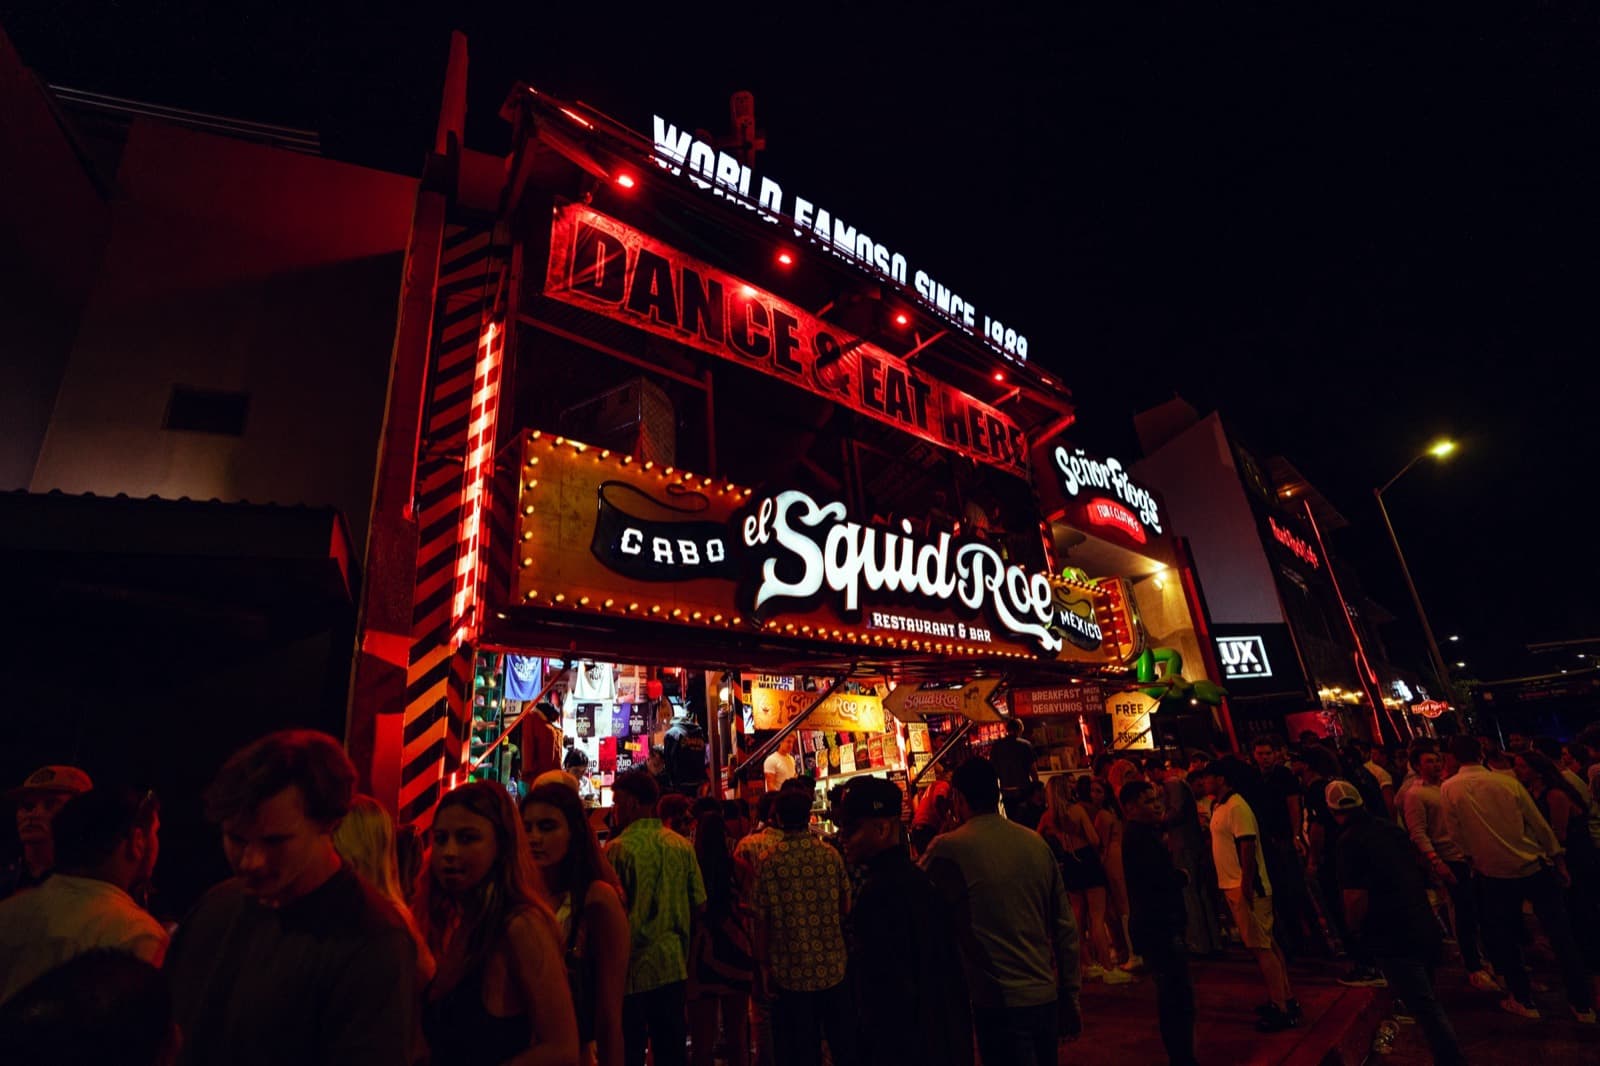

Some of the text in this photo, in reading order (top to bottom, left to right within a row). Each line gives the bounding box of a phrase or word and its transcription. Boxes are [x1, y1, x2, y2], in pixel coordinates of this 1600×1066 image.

[652, 114, 1028, 367] WORLD FAMOSO SINCE 1989
[570, 220, 1028, 469] DANCE & EAT HERE
[1055, 446, 1162, 534] Señor Frog's
[743, 498, 770, 547] el
[620, 527, 725, 566] CABO
[754, 489, 1062, 651] Squid Roe
[873, 612, 992, 643] RESTAURANT & BAR
[1060, 610, 1103, 640] MÉXICO
[1218, 641, 1258, 664] UX
[1032, 688, 1081, 701] BREAKFAST
[1032, 702, 1082, 713] DESAYUNOS
[1115, 703, 1144, 714] FREE
